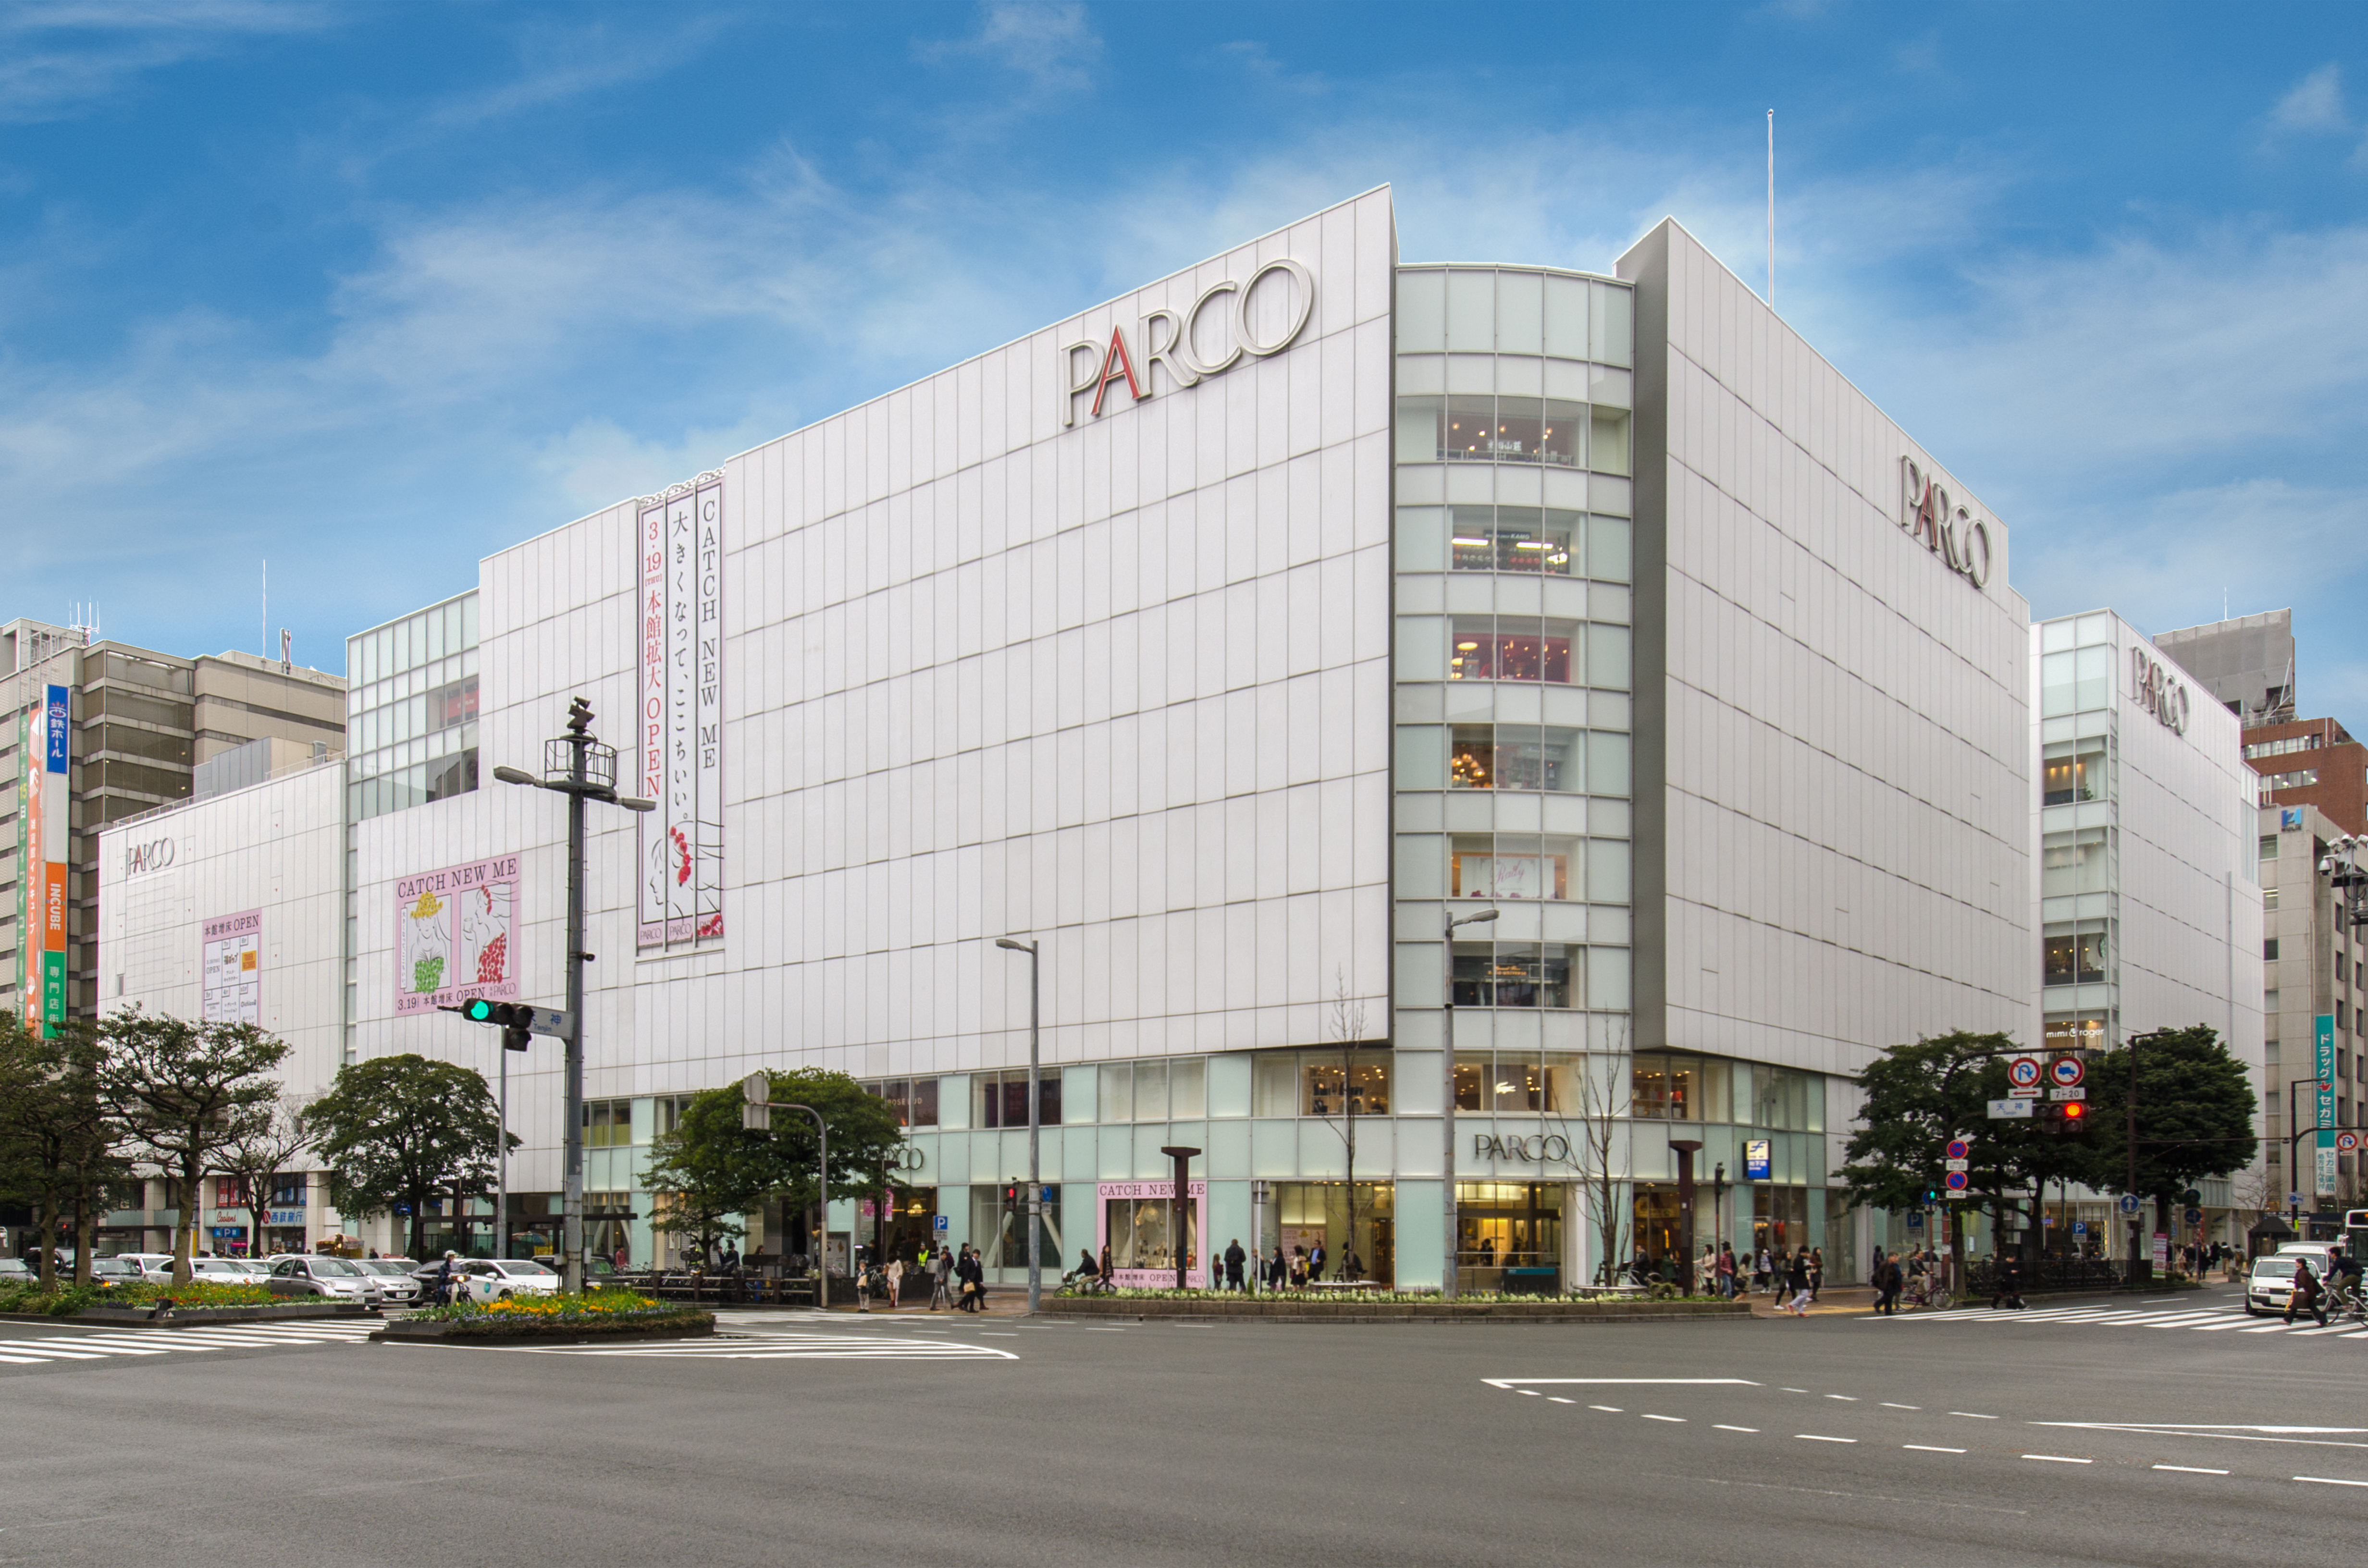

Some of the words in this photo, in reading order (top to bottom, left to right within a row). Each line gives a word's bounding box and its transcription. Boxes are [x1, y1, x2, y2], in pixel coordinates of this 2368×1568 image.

[1061, 259, 1313, 426] PARCO
[1901, 455, 1991, 588] PARCO
[702, 500, 716, 623] CATCH
[701, 638, 717, 706] NEW
[2133, 647, 2189, 735] PARCO
[701, 724, 717, 769] ME
[128, 836, 175, 875] PARCO
[398, 874, 445, 898] CATCH
[451, 865, 486, 887] NEW
[493, 858, 517, 879] ME
[50, 883, 61, 931] INCUBE
[234, 915, 259, 931] OPEN
[640, 928, 662, 941] PARCO
[669, 923, 691, 936] PARCO
[398, 997, 417, 1010] 3.19
[456, 987, 485, 1002] OPEN
[493, 982, 516, 997] PARCO
[533, 1023, 551, 1032] Tenjin
[2319, 1034, 2330, 1078] ドラッグ
[1997, 1103, 2023, 1111] 天神
[2319, 1095, 2331, 1128] セガミ
[1475, 1134, 1568, 1162] PARCO
[1099, 1185, 1141, 1196] CATCH
[271, 1212, 303, 1223] 西鉄旅行
